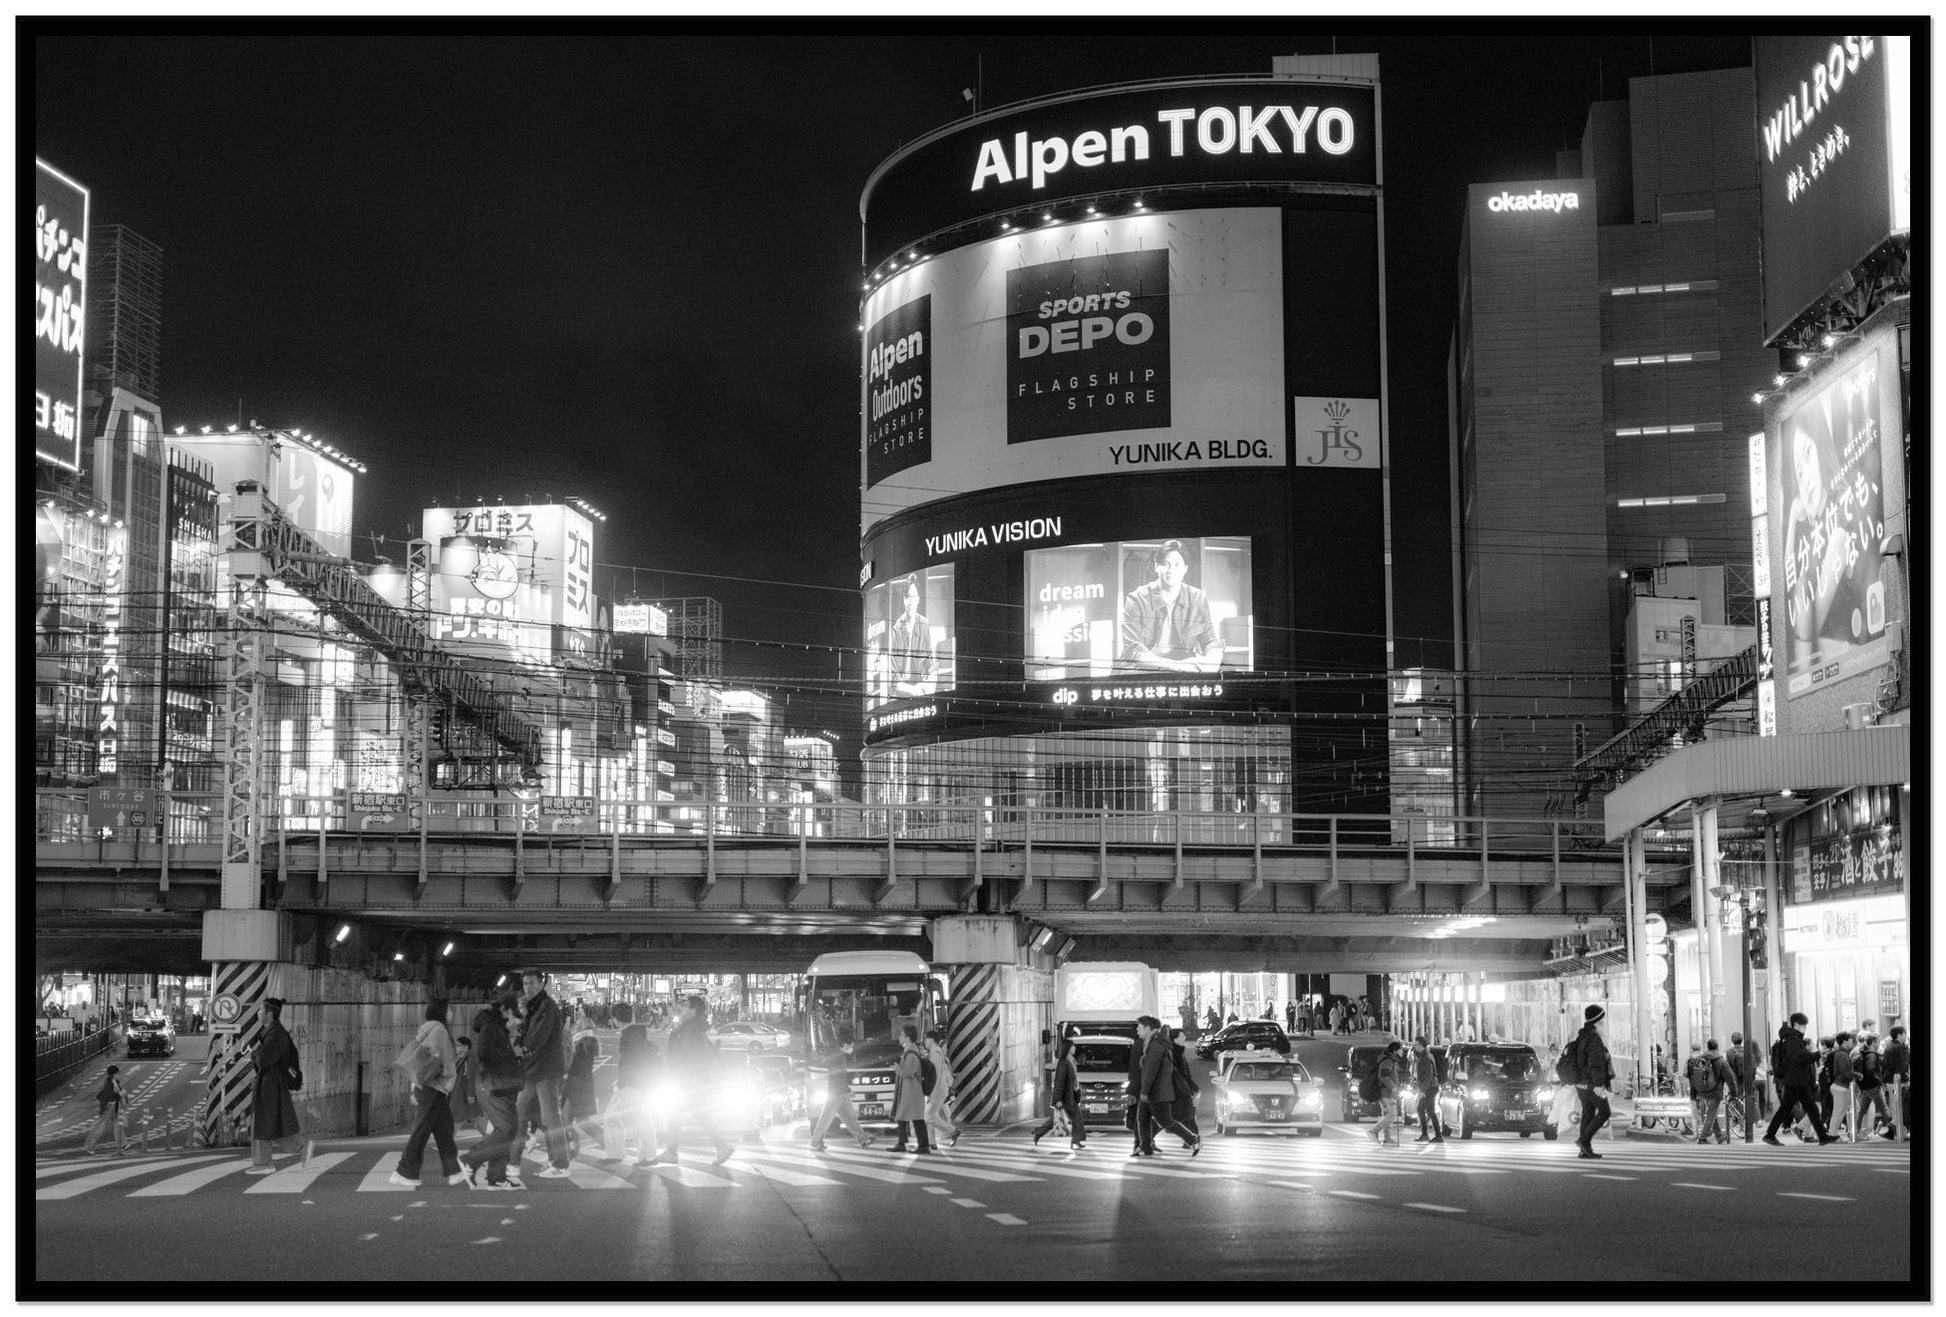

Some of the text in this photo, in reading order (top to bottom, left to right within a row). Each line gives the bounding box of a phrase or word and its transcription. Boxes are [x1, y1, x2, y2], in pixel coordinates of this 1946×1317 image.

[971, 105, 1354, 191] Alpen TOKYO
[1488, 190, 1579, 213] okadaya
[1038, 291, 1132, 320] SPORTS
[1019, 312, 1154, 359] DEPO
[869, 330, 923, 384] Alpen
[1019, 369, 1155, 397] FLAGSHIP
[872, 374, 923, 423] Outdoors
[1068, 390, 1155, 410] STORE
[869, 408, 924, 447] FLAGSHIP
[884, 427, 924, 455] STORE
[1109, 439, 1273, 465] YUNIKA BLDG.
[178, 517, 213, 541] SHISHA
[453, 511, 534, 533] プロミス
[925, 516, 1062, 556] YUNIKA VISION
[1040, 583, 1104, 602] dream
[1053, 688, 1078, 705] dip
[1091, 684, 1223, 701] 夢を叶える仕事に出会おう
[352, 793, 405, 806] 新宿駅東口
[542, 797, 593, 809] 新宿駅東口
